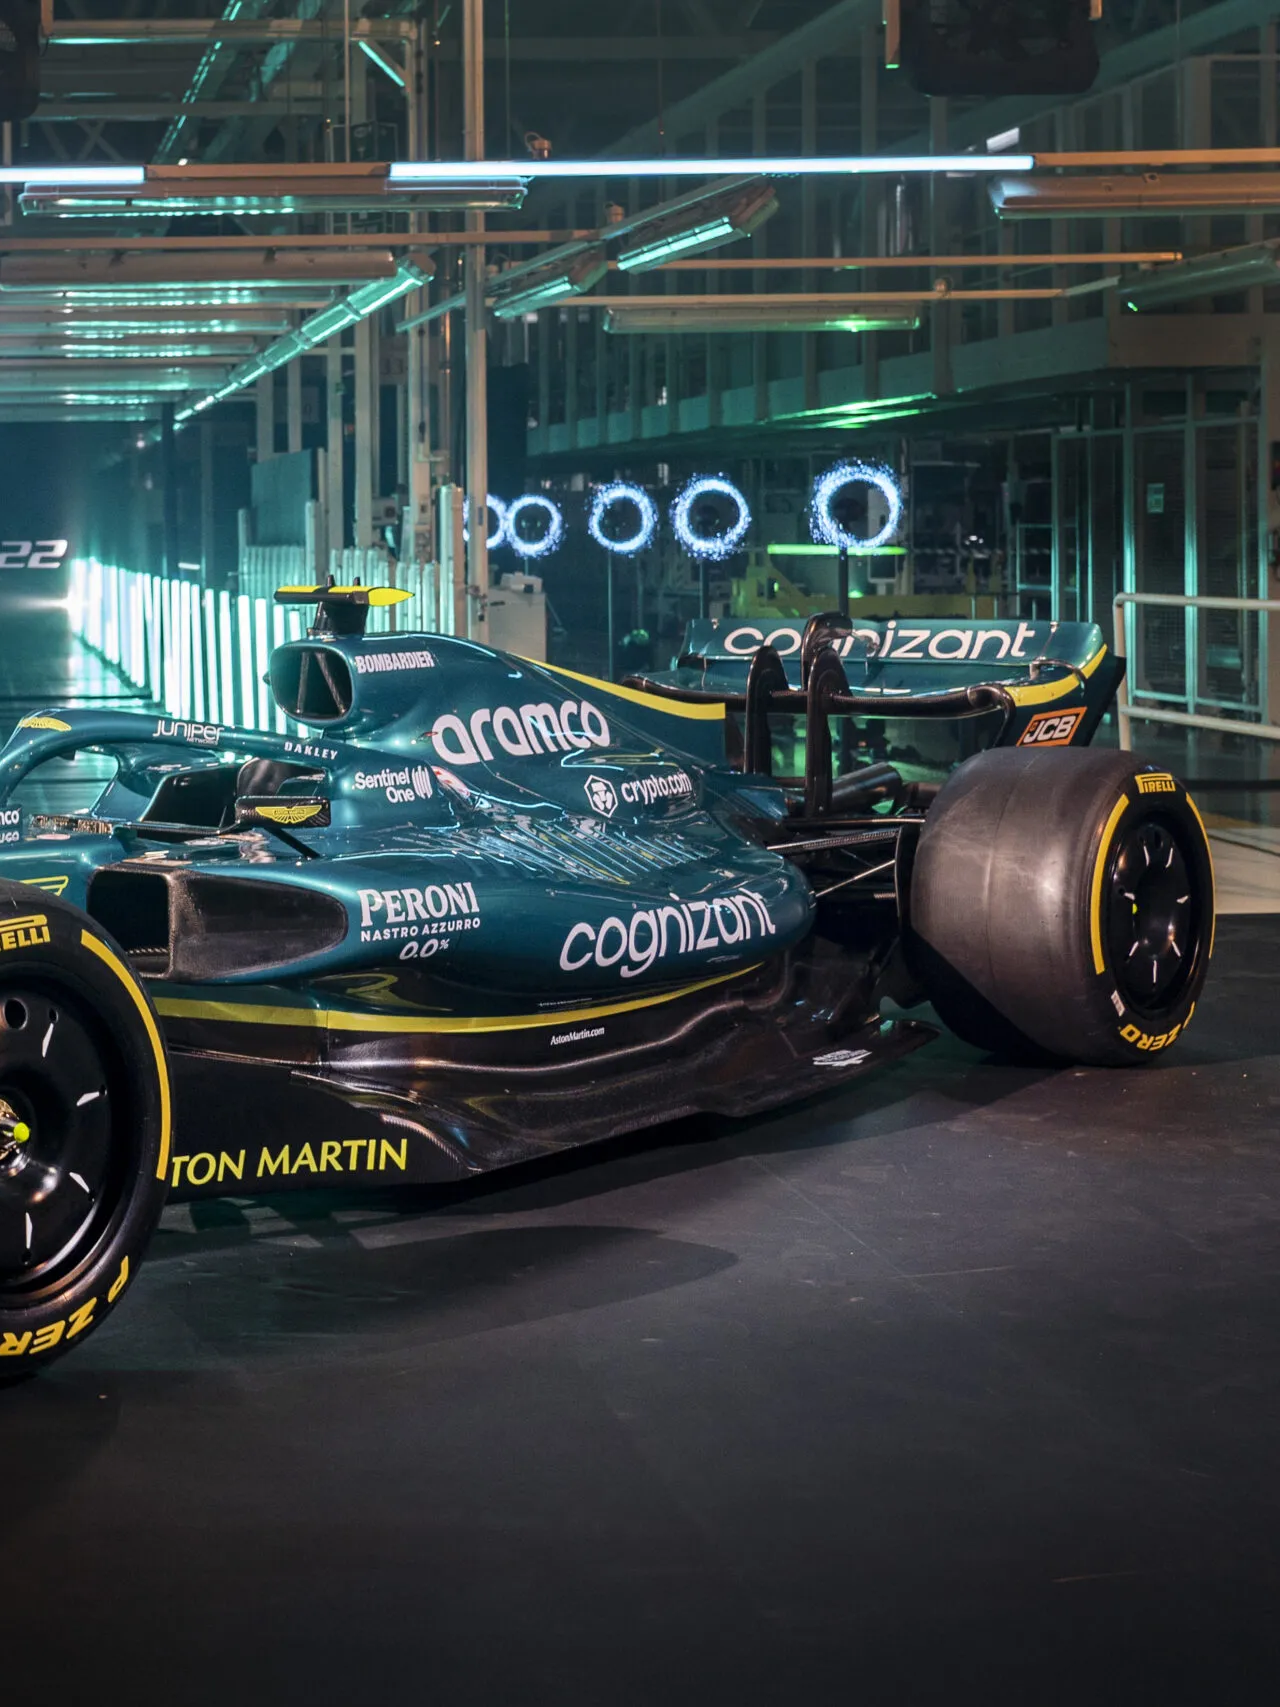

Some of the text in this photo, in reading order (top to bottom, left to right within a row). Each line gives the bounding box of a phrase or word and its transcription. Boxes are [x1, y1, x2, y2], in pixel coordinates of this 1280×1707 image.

[723, 620, 1036, 660] conizant
[355, 650, 435, 674] BOMBARDIER
[431, 700, 611, 766] aramco
[1023, 715, 1077, 744] JCB
[284, 741, 338, 760] OAKLEY
[386, 786, 415, 804] One
[621, 771, 692, 805] crypto.com
[1134, 772, 1176, 794] PIRELLI
[357, 881, 480, 927] PERONI
[360, 917, 481, 942] NASTRO AZZURRO
[559, 887, 776, 979] cognizant
[399, 938, 450, 960] 0.0%
[550, 1026, 605, 1046] AstonMartin.com
[1119, 1023, 1182, 1052] ZERO
[256, 1138, 408, 1178] MARTIN
[107, 1255, 129, 1303] P
